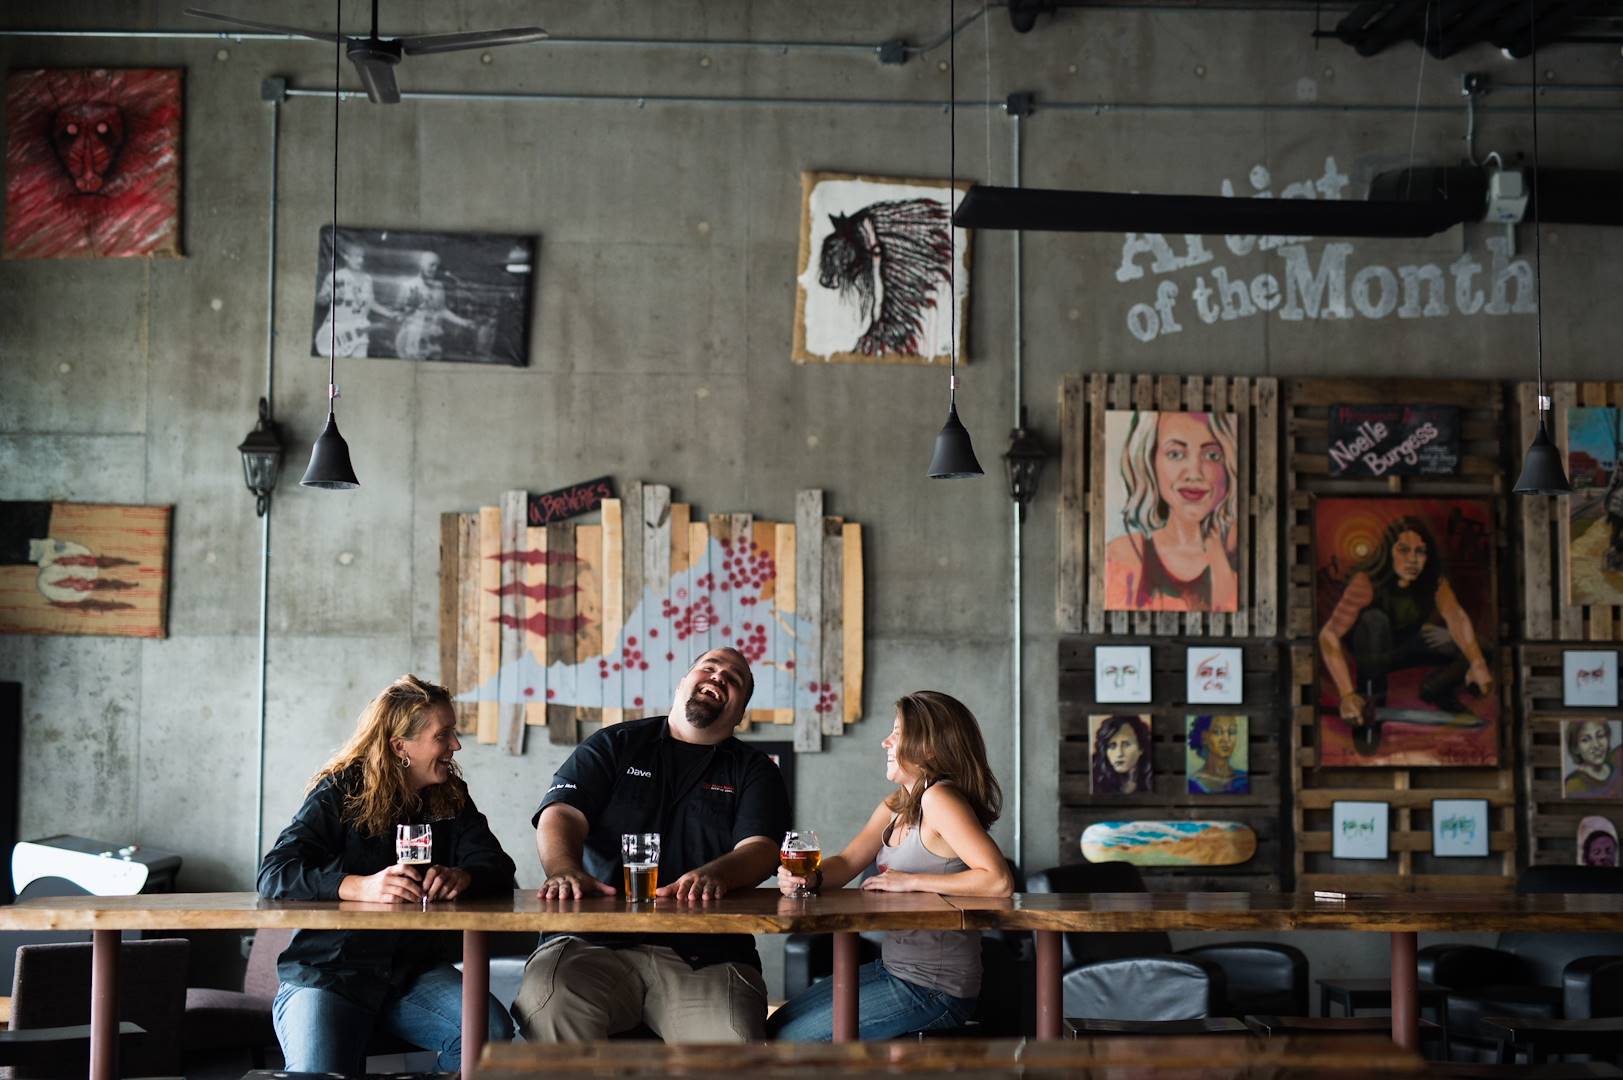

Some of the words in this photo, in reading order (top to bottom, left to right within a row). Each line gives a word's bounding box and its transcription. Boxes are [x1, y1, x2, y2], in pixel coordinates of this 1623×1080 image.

[1127, 280, 1183, 343] of
[1192, 266, 1281, 325] the
[1278, 236, 1537, 321] Month
[1329, 420, 1388, 471] Noelle
[1363, 421, 1439, 476] Burgess
[626, 766, 652, 779] Dave
